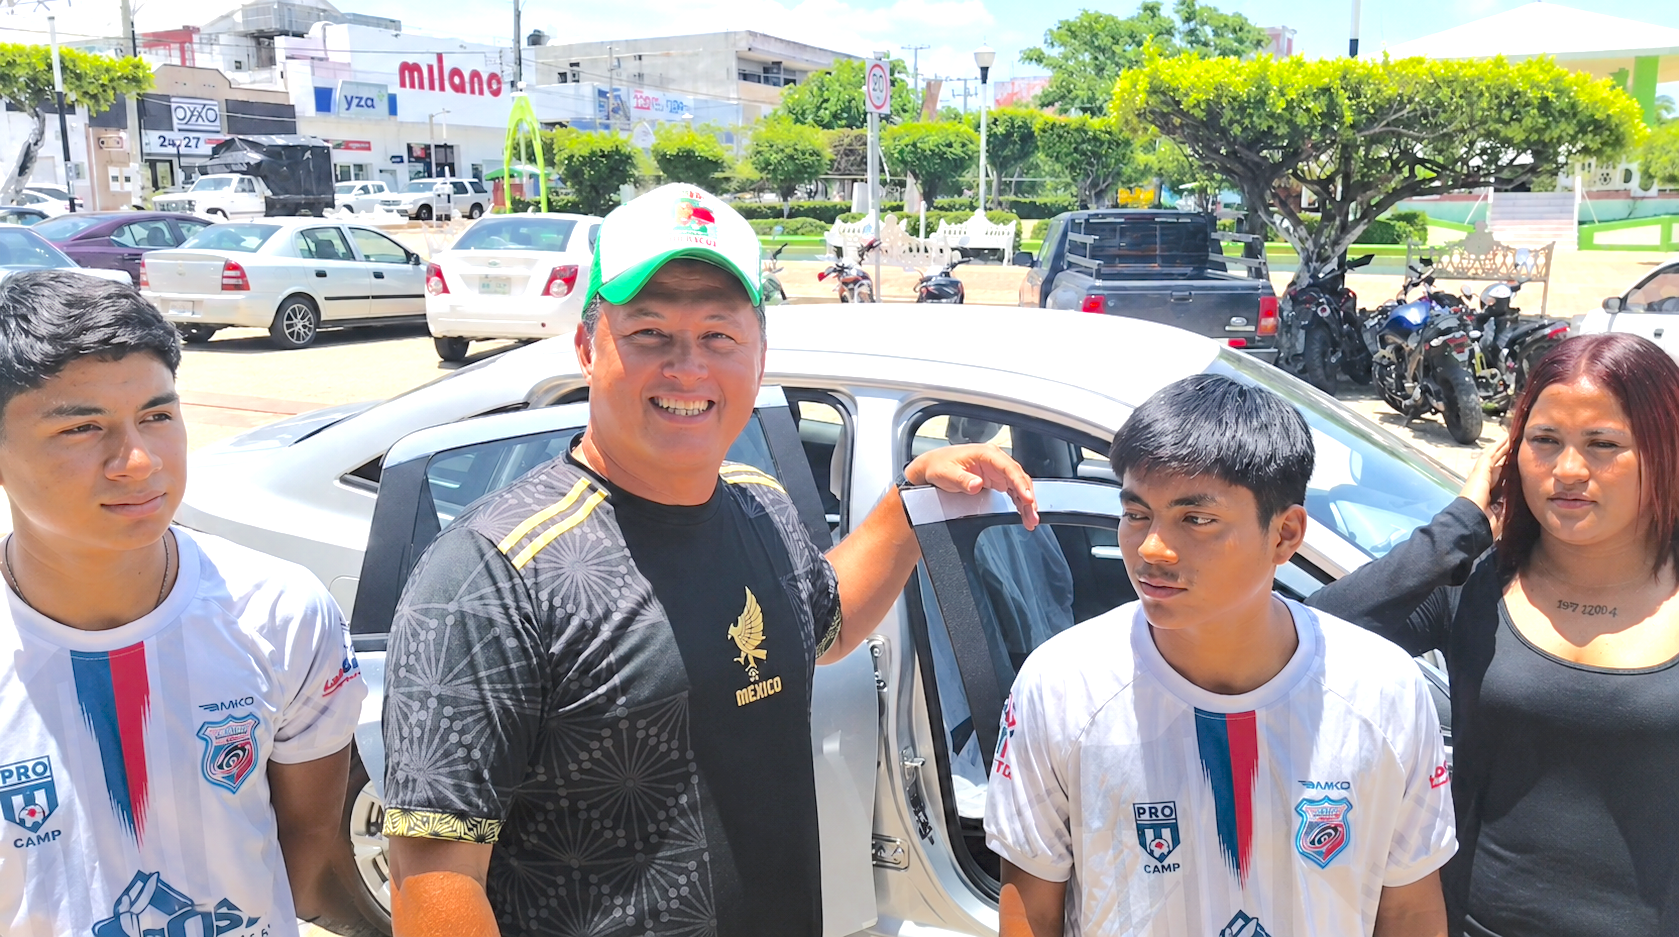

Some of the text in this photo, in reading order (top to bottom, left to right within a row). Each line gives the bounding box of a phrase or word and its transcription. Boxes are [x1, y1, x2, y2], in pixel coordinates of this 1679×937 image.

[398, 52, 502, 98] milano
[344, 94, 376, 111] yza
[735, 676, 782, 707] MEXICO
[0, 760, 49, 785] PRO
[1136, 805, 1174, 819] PRO
[13, 829, 62, 848] CAMP
[1143, 863, 1180, 874] CAMP
